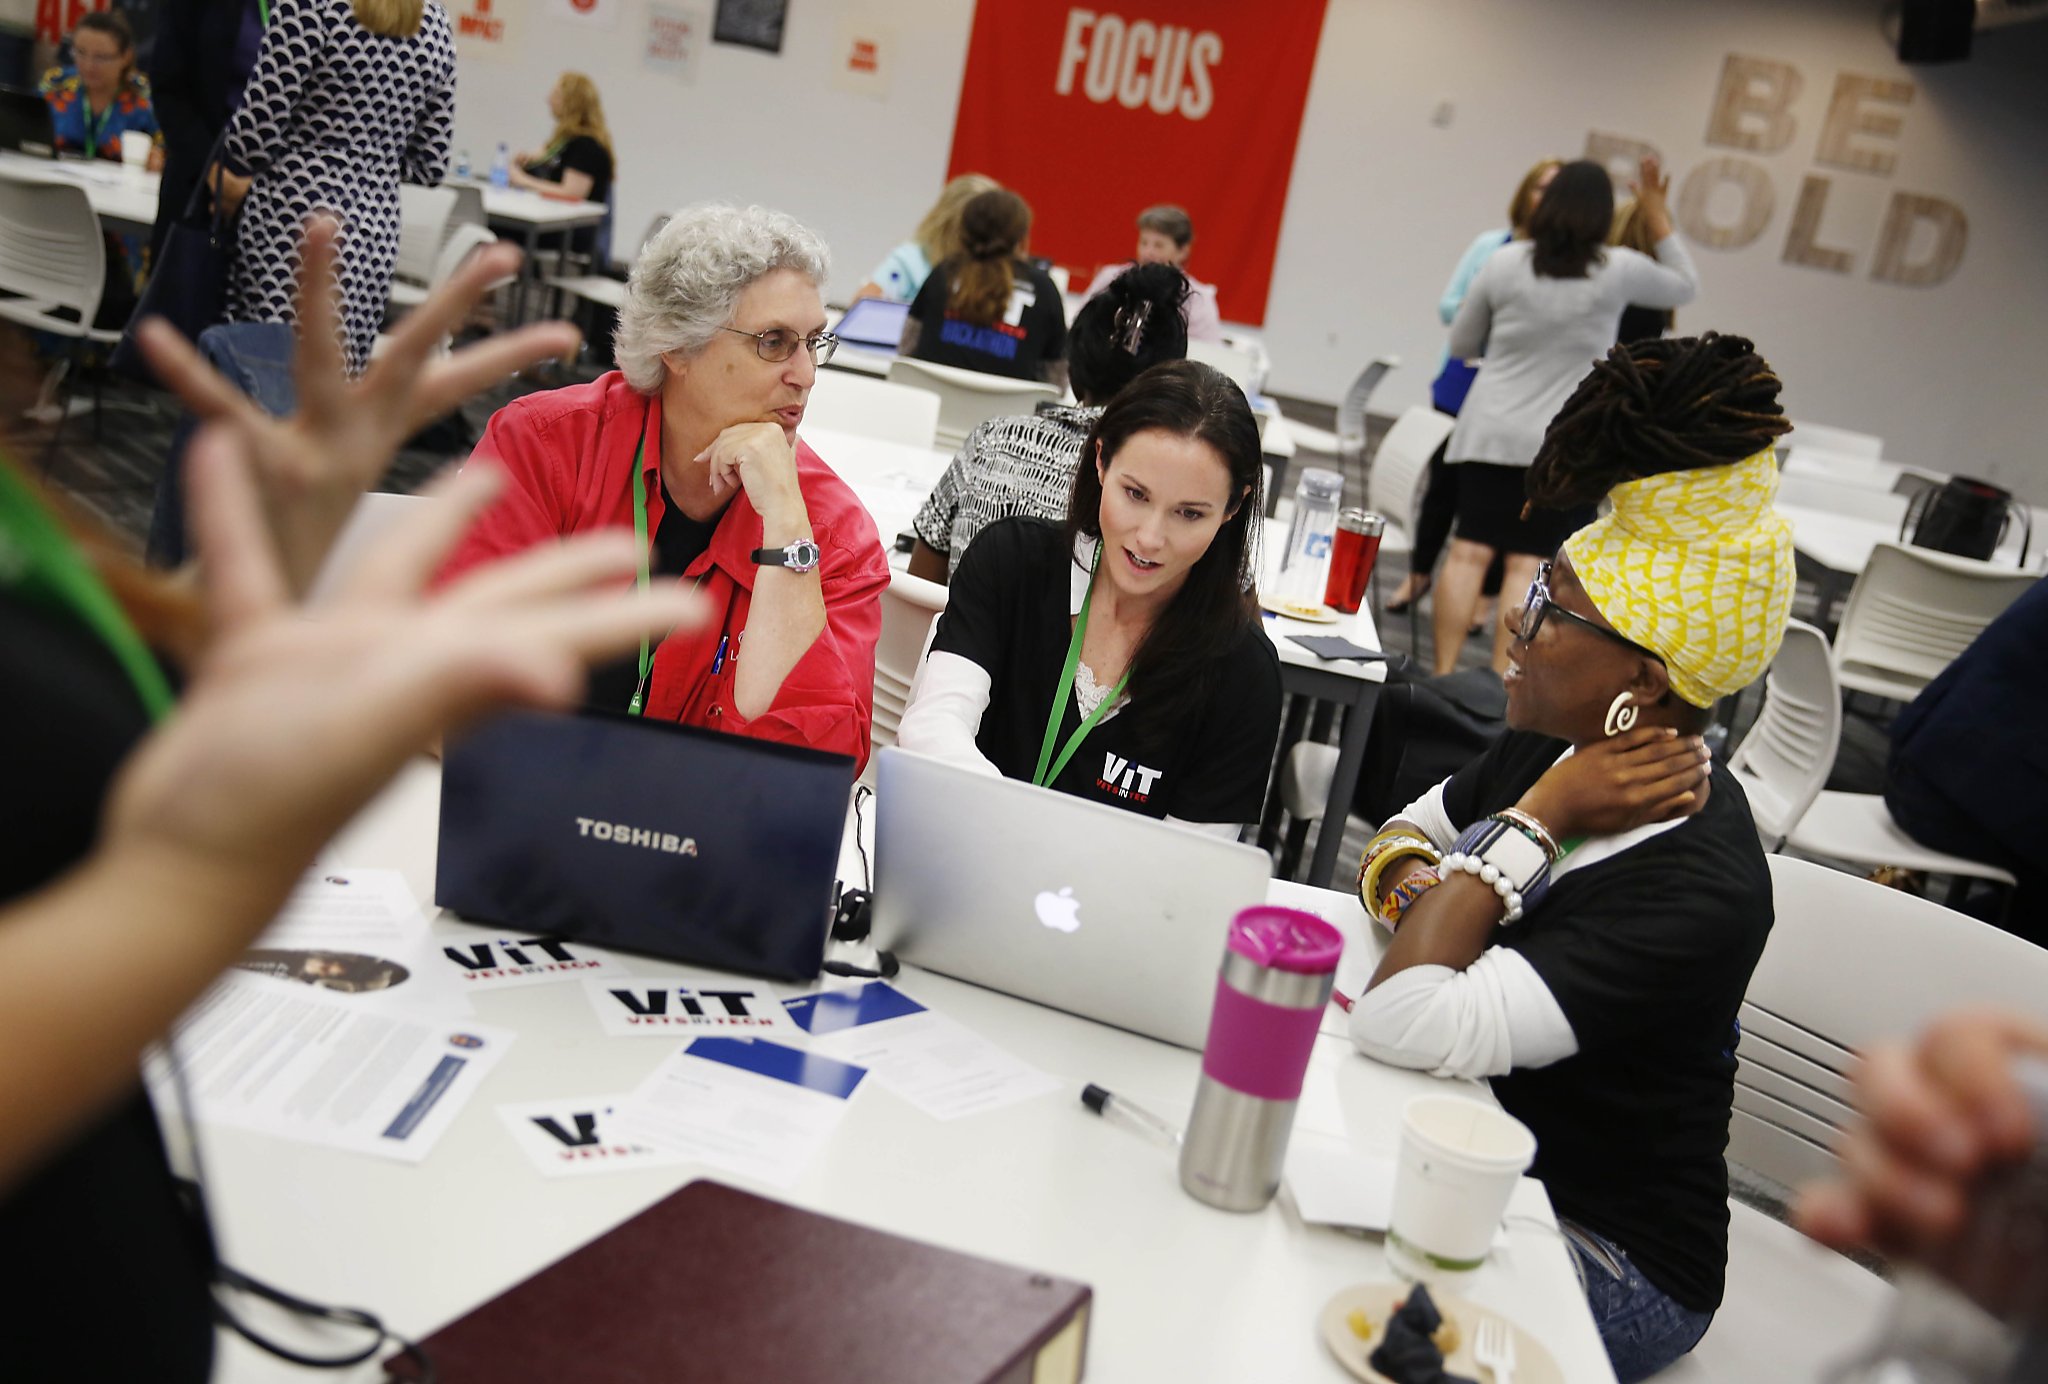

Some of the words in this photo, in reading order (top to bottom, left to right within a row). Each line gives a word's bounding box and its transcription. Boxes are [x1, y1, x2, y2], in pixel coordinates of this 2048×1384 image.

[1055, 7, 1223, 121] FOCUS
[1705, 52, 1916, 177] BE
[576, 816, 698, 857] TOSHIBA
